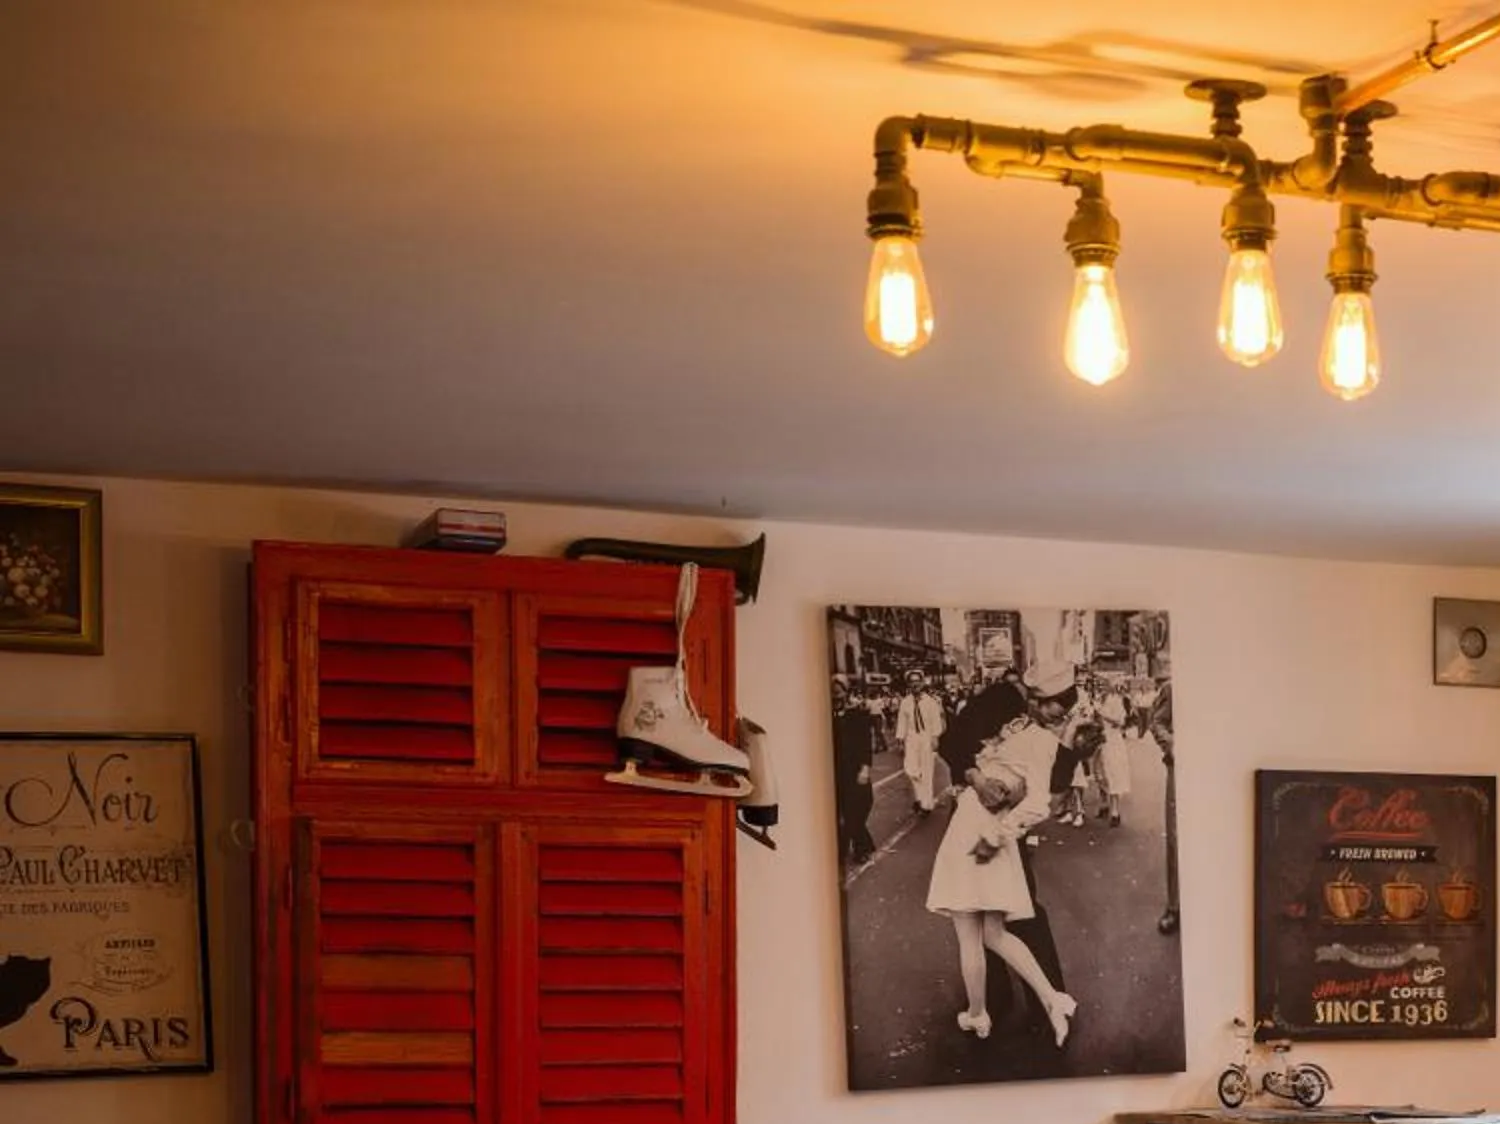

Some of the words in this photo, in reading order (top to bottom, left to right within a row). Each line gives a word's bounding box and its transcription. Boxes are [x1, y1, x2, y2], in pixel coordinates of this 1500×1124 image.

[5, 752, 158, 827] Noir
[1329, 786, 1431, 829] Coffee
[1315, 1000, 1384, 1023] SINCE
[1389, 1000, 1448, 1026] 1936
[1390, 986, 1446, 999] COFFEE
[50, 997, 190, 1062] PARIS
